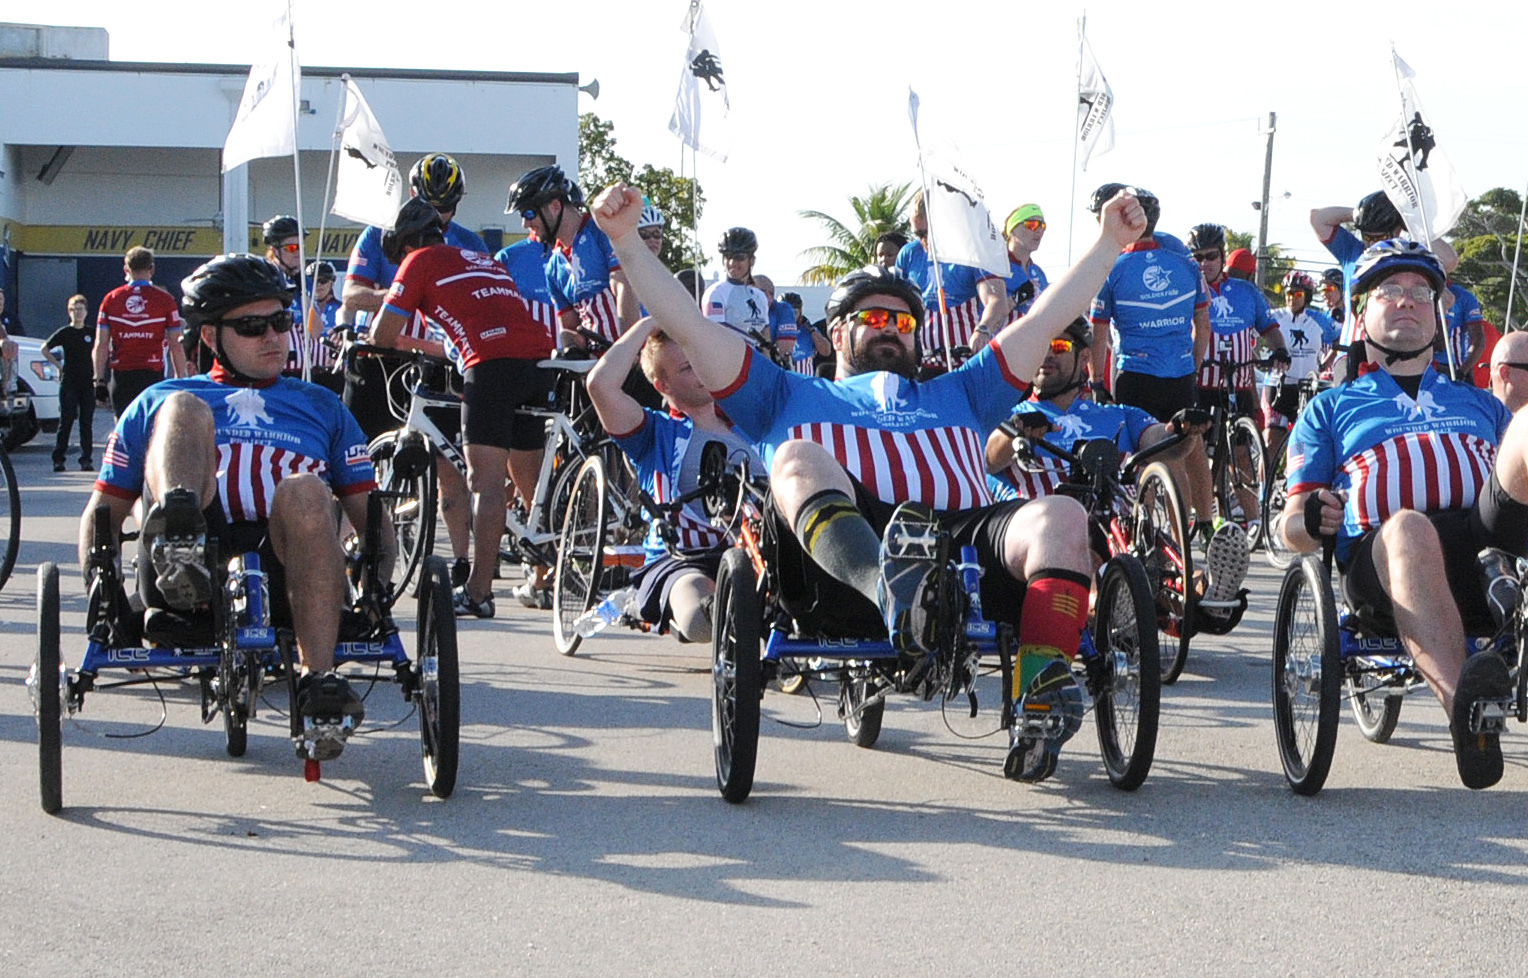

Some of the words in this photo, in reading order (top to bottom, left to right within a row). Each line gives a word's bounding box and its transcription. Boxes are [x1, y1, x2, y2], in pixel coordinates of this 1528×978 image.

[84, 230, 135, 250] NAVY
[144, 230, 197, 250] CHIEF
[1139, 317, 1185, 329] WARRIOR
[434, 305, 475, 358] TEAMMATE
[1385, 424, 1430, 435] WOUNDED
[1432, 419, 1477, 429] WARRIOR
[254, 431, 301, 444] WARRIOR
